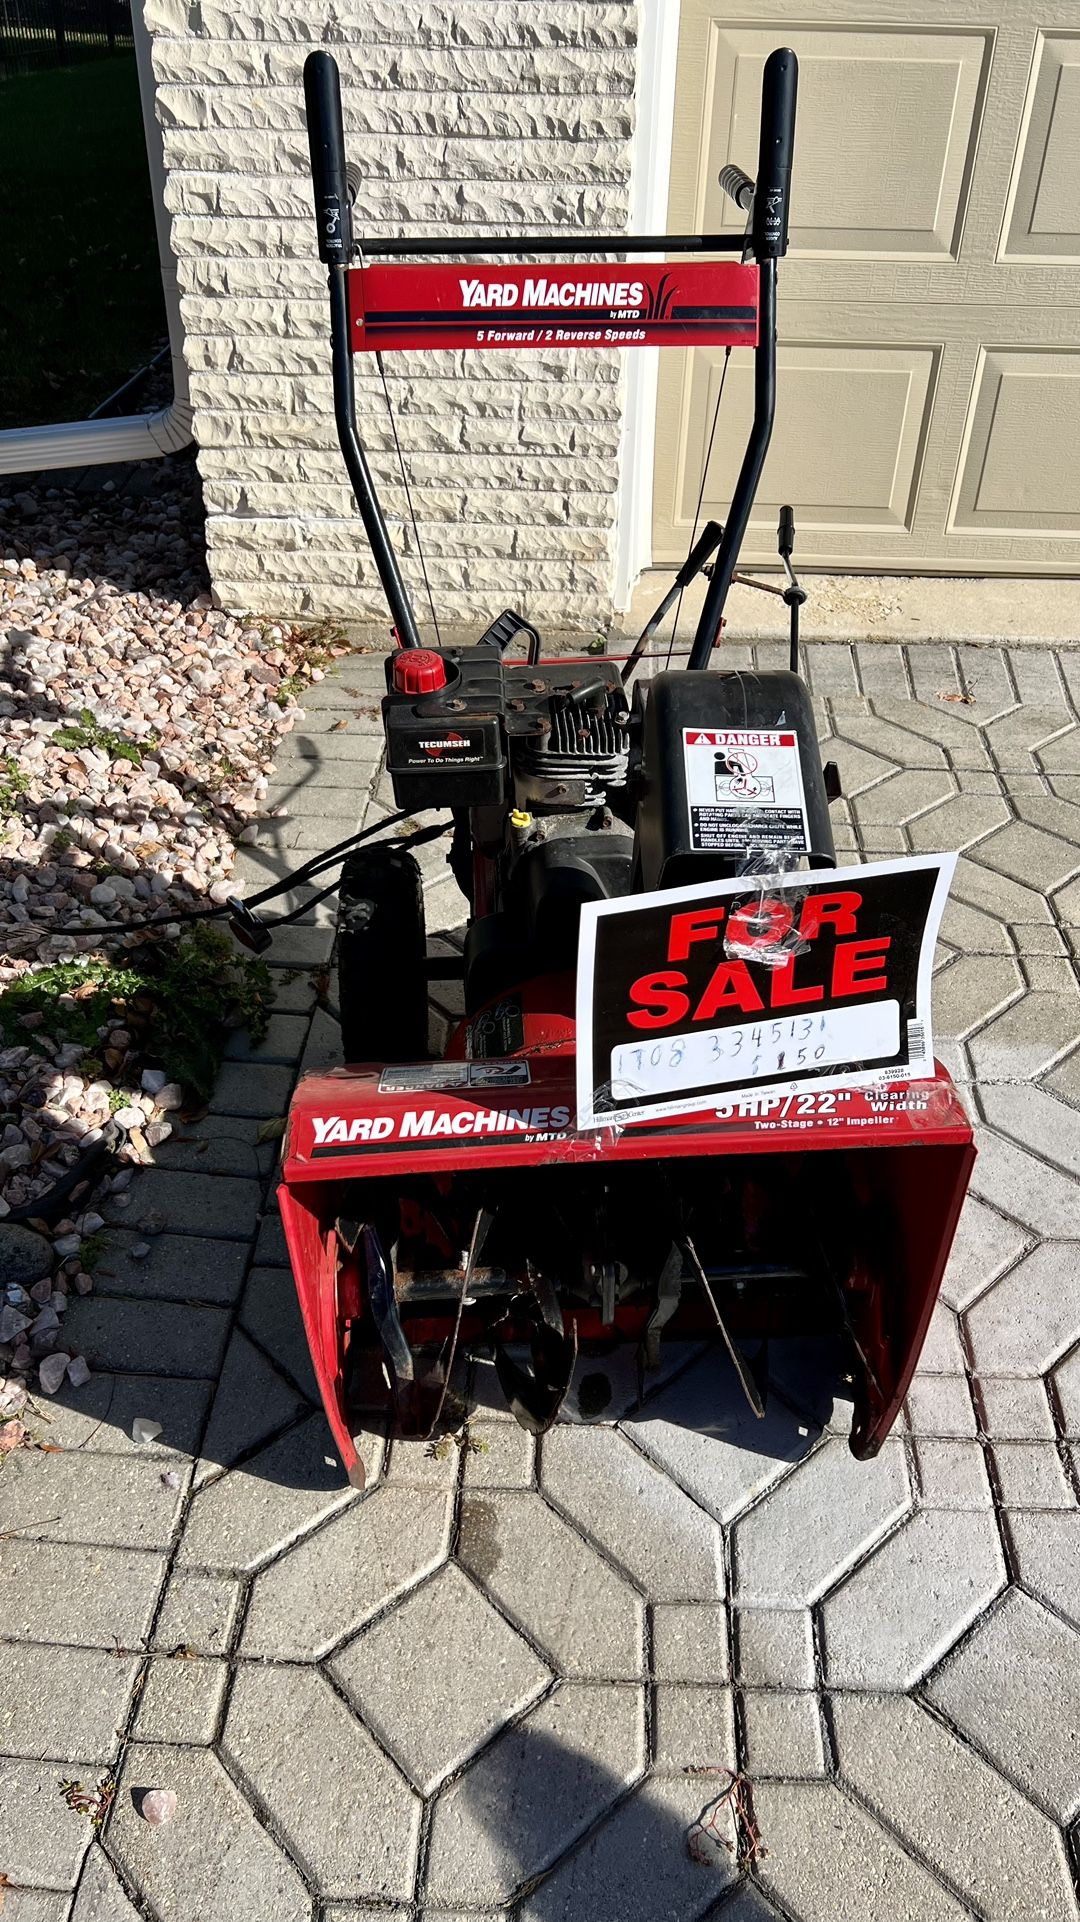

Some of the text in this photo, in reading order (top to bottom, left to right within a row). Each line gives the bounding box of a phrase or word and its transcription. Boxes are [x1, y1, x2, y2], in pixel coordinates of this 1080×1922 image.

[459, 279, 643, 306] YARD MACHINES
[618, 310, 640, 318] MTD
[477, 329, 645, 341] 5 Forward / 2 Reverse Speeds
[419, 740, 470, 748] TECUMSEH
[715, 734, 780, 745] DANGER
[667, 892, 862, 962] FOR
[626, 937, 891, 1029] SALE
[864, 1091, 929, 1100] Clearing
[871, 1101, 927, 1111] Width
[312, 1106, 570, 1144] YARD MACHINES
[754, 1116, 894, 1129] Two-Stage 12" Impeller
[525, 1132, 567, 1142] by MTD
